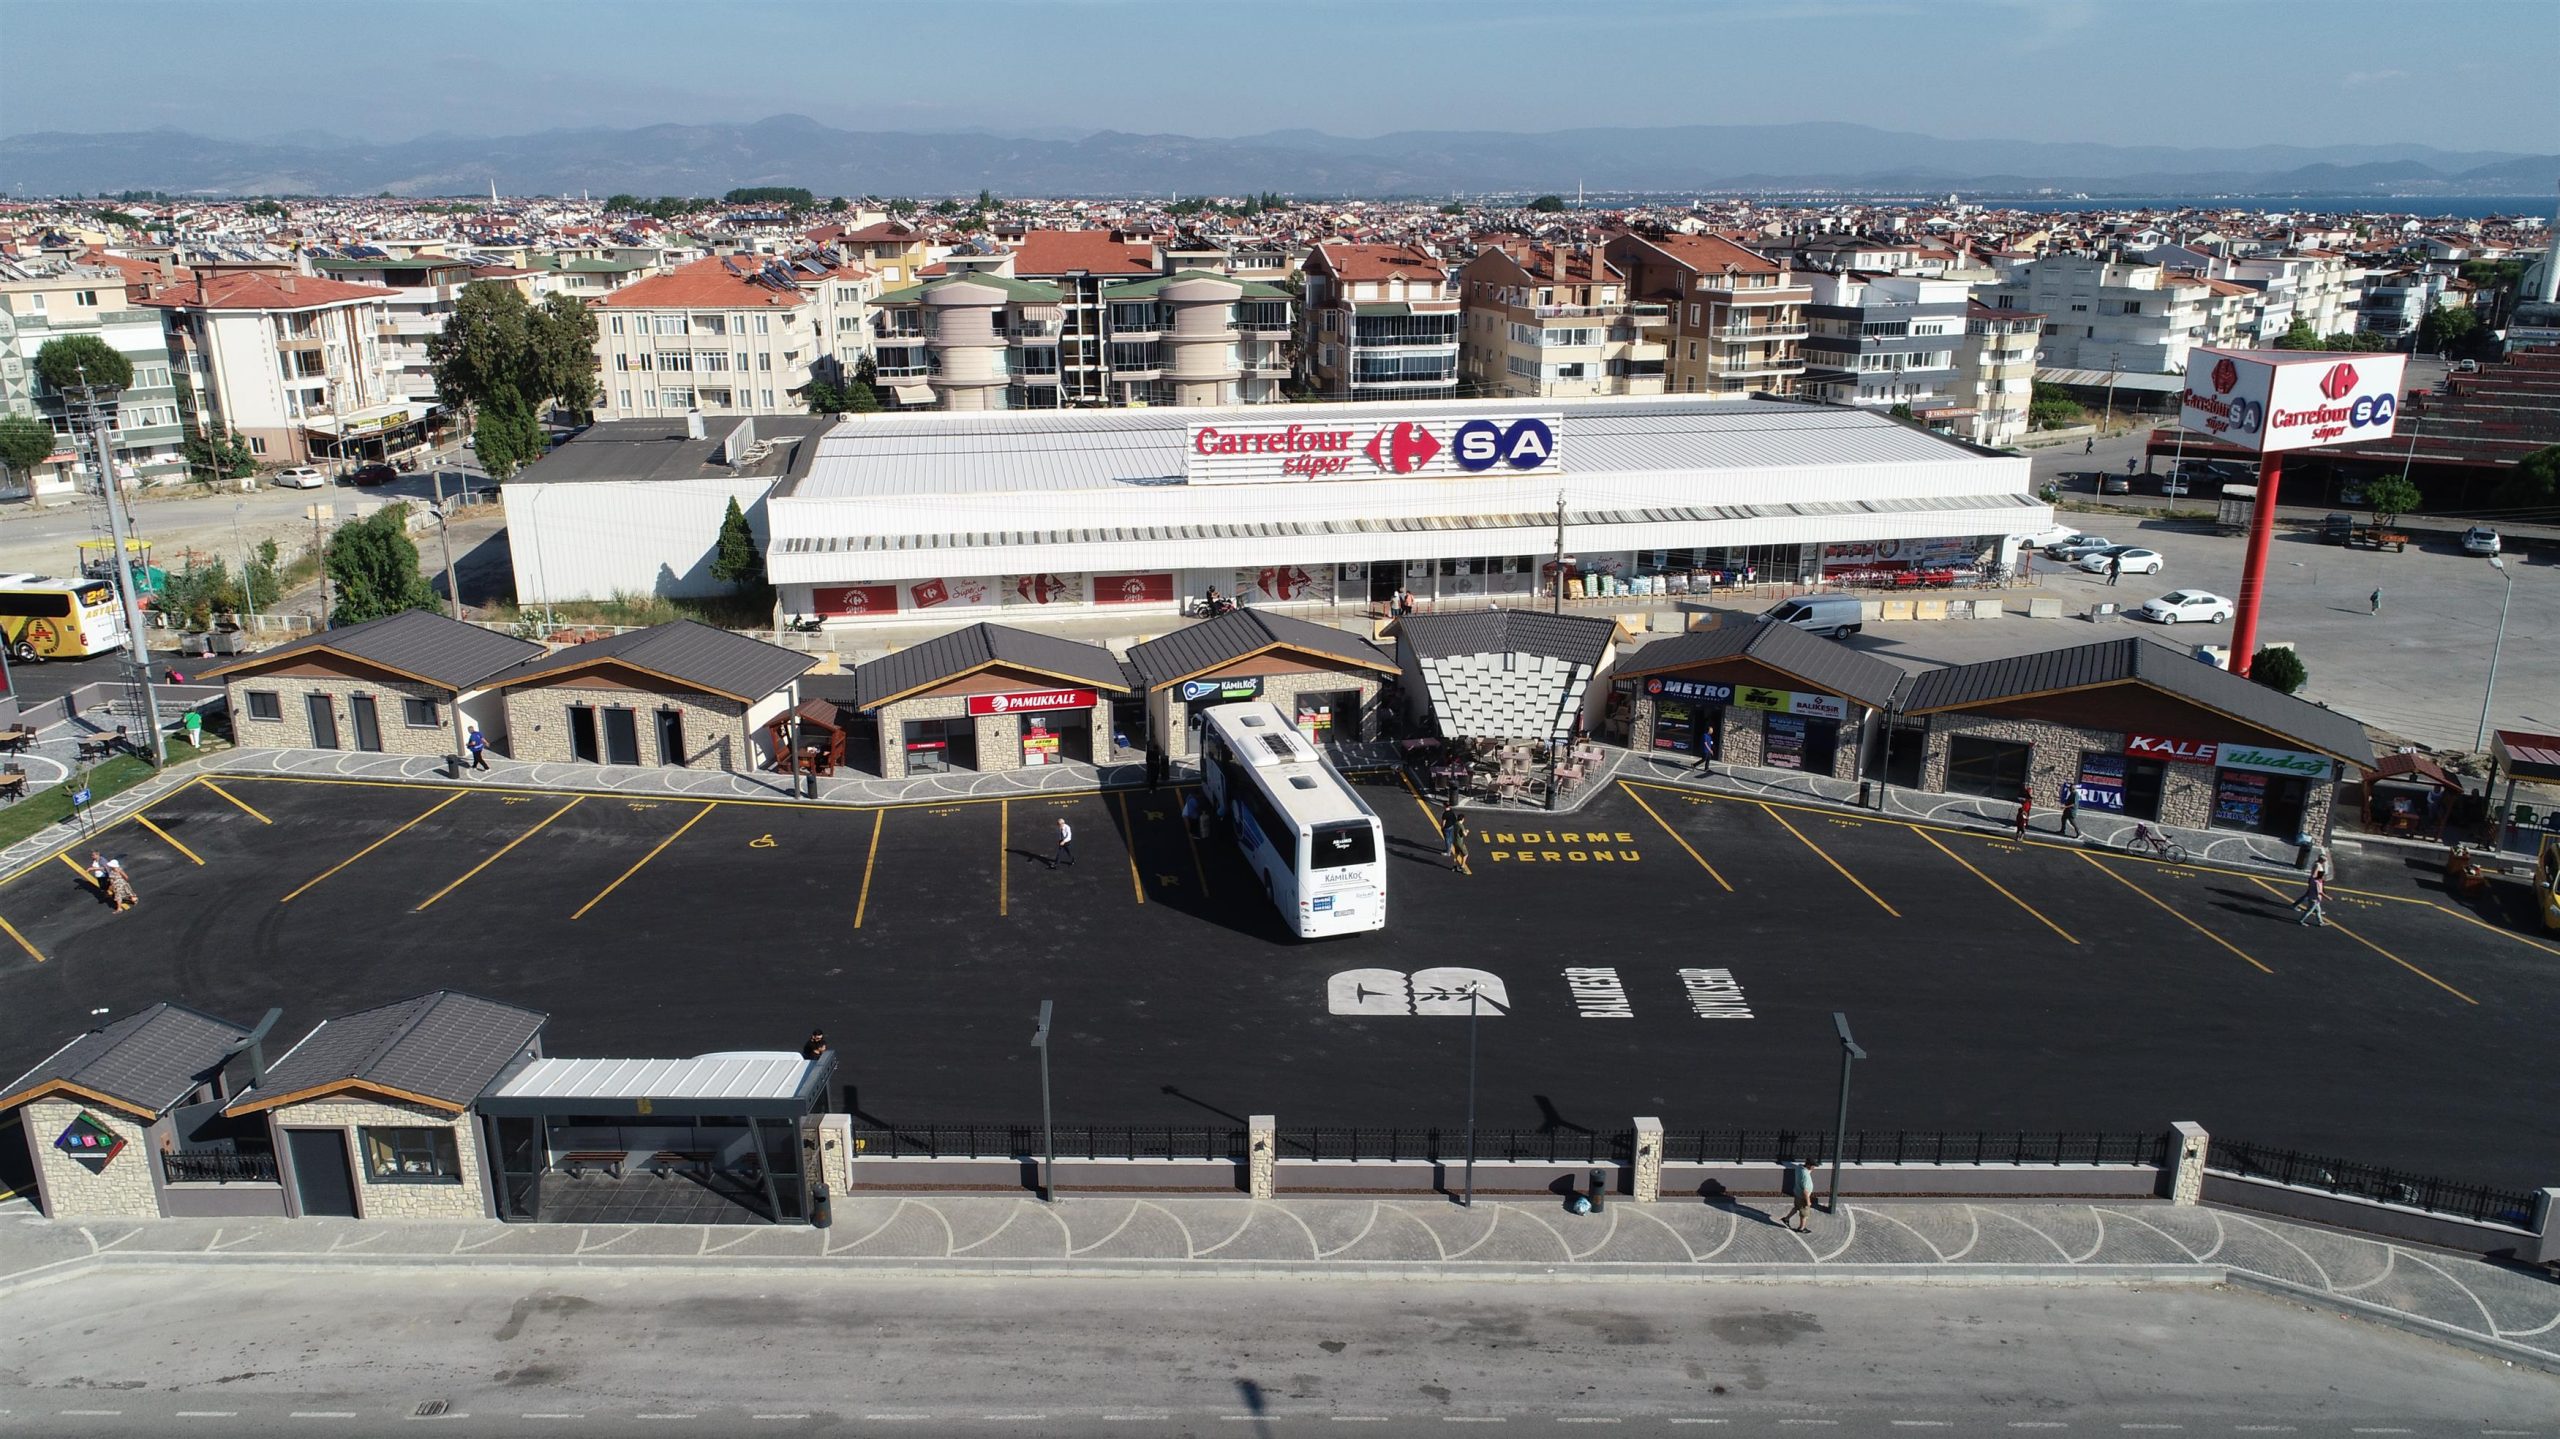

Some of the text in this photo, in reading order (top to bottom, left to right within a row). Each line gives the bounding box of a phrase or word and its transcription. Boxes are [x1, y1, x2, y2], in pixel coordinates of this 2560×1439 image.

[2183, 388, 2256, 429] Carrefour SA
[2272, 400, 2393, 429] Carrefour SA
[2205, 416, 2230, 437] süper
[2312, 426, 2347, 443] süper
[1195, 424, 1547, 460] Carrefour SA
[1283, 454, 1353, 479] süper
[1664, 680, 1730, 698] METRO
[1010, 693, 1076, 709] PAMUKKALE
[1796, 702, 1840, 713] BALIKESİR
[2129, 736, 2217, 758] KALE
[2227, 750, 2331, 775] uludağ
[1481, 830, 1634, 844] İNDİRME
[1491, 850, 1641, 863] PERONU
[1561, 967, 1755, 1019] BALIKESİR BÜYÜKŞEHİR
